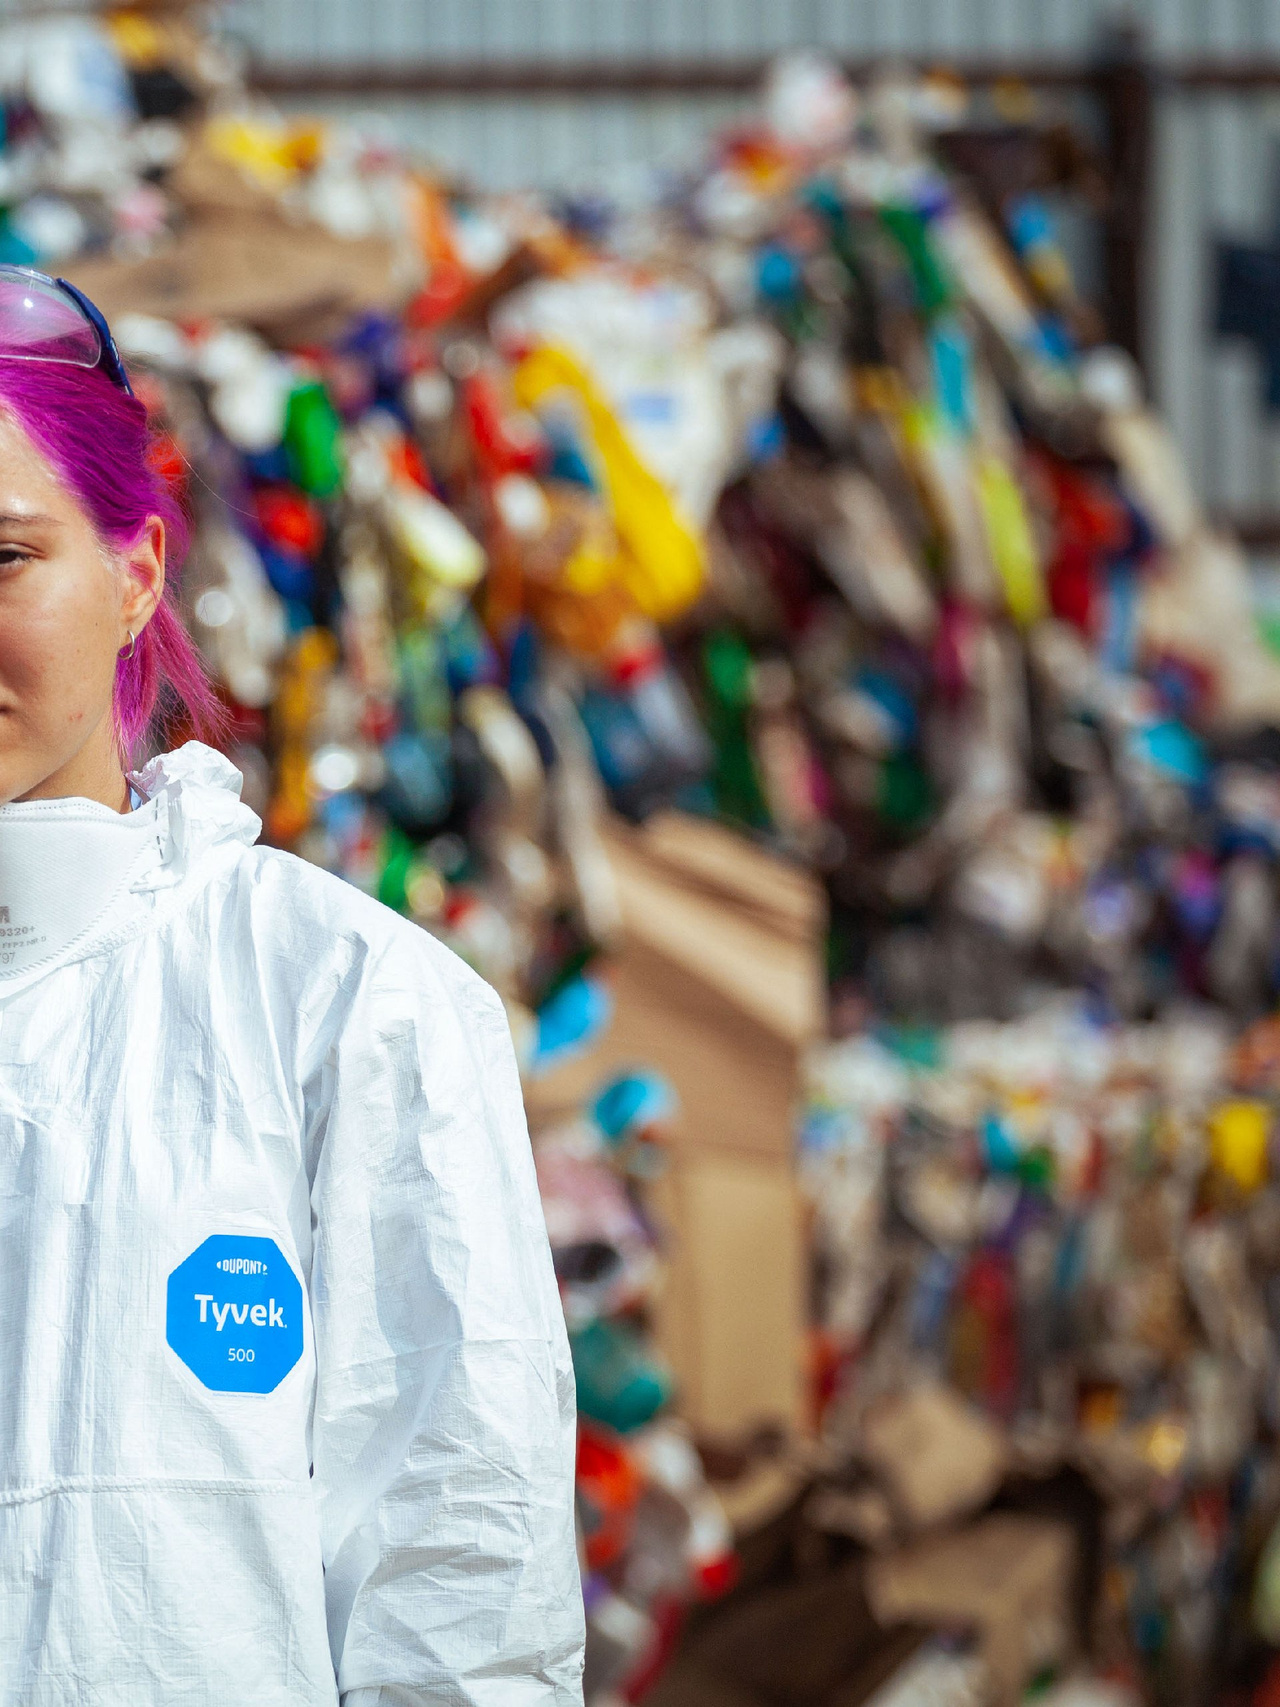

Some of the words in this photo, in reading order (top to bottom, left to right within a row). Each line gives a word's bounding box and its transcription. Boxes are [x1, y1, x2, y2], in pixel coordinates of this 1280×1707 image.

[0, 926, 36, 937] 9320+
[222, 1258, 262, 1275] DUPONT
[194, 1294, 284, 1331] Tyvek
[228, 1348, 255, 1362] 500
